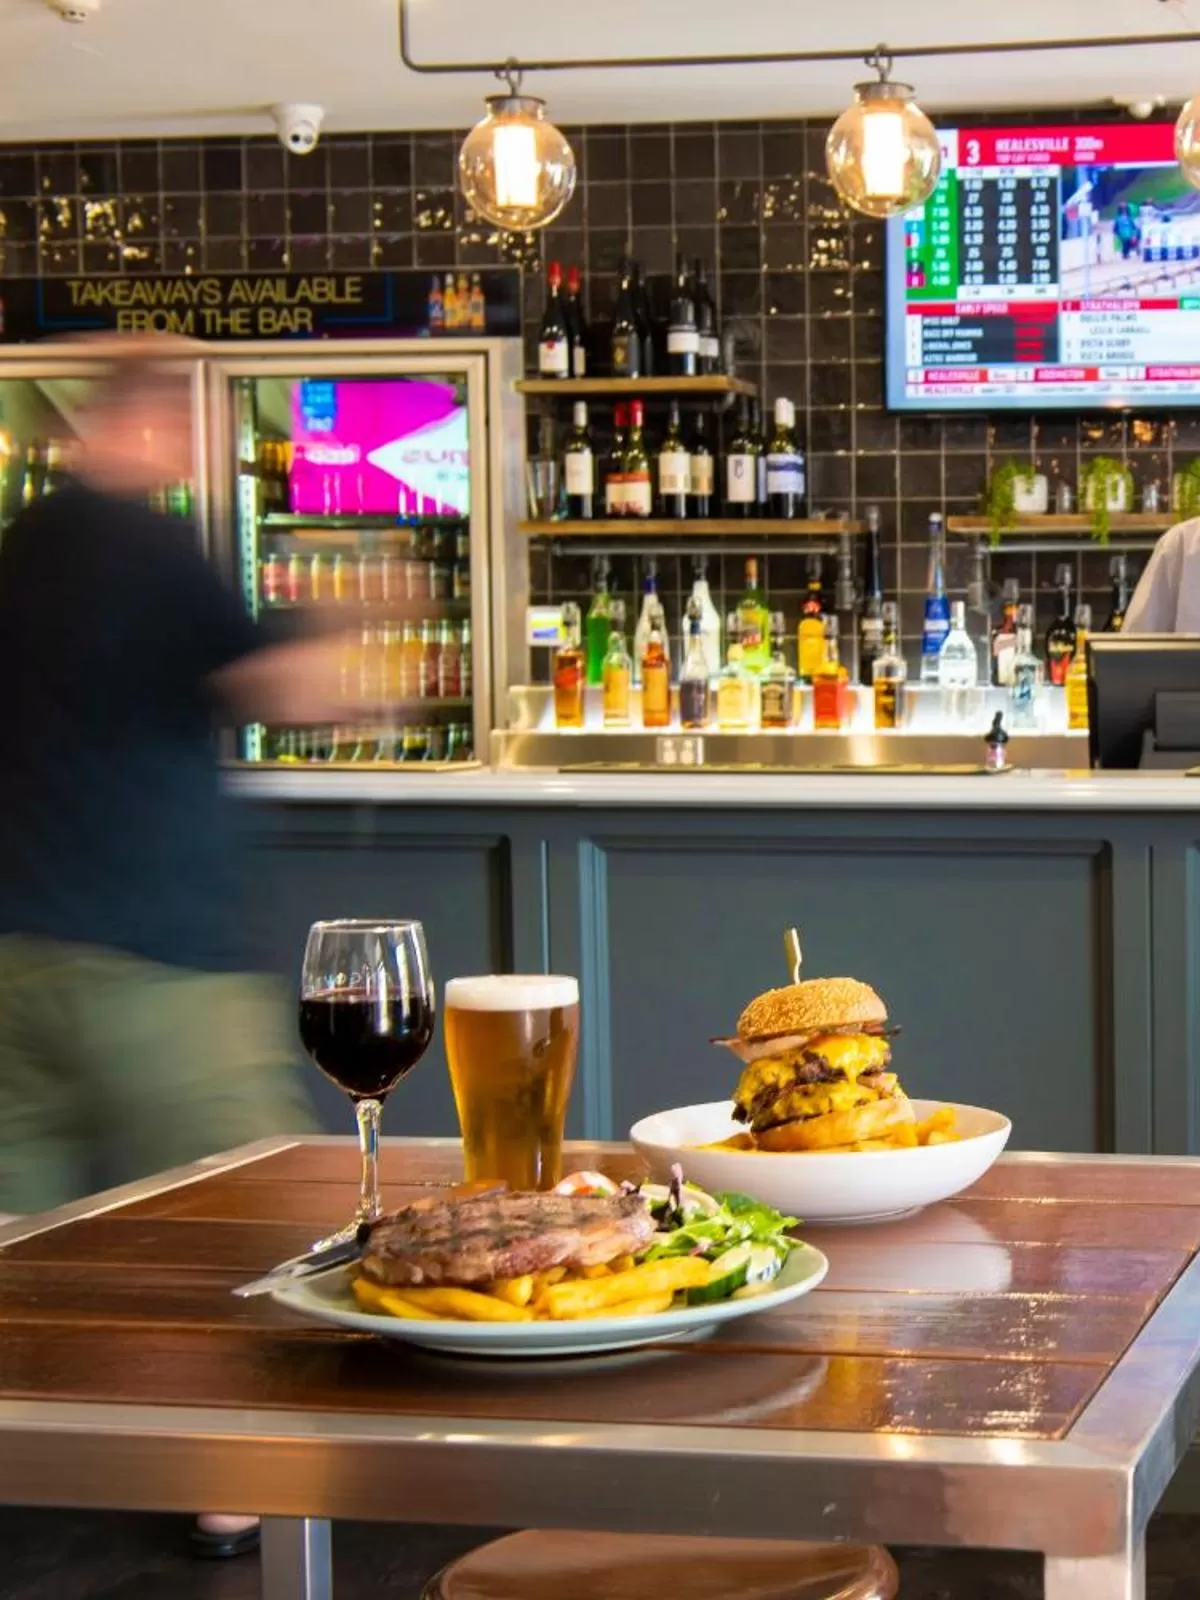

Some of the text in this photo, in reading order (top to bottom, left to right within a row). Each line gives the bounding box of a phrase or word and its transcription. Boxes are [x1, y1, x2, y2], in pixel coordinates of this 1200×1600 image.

[966, 139, 981, 166] 3
[995, 137, 1069, 152] HEALESVILLE
[66, 275, 363, 307] TAKEAWAYS AVAILABLE
[116, 307, 313, 334] FROM THE BAR
